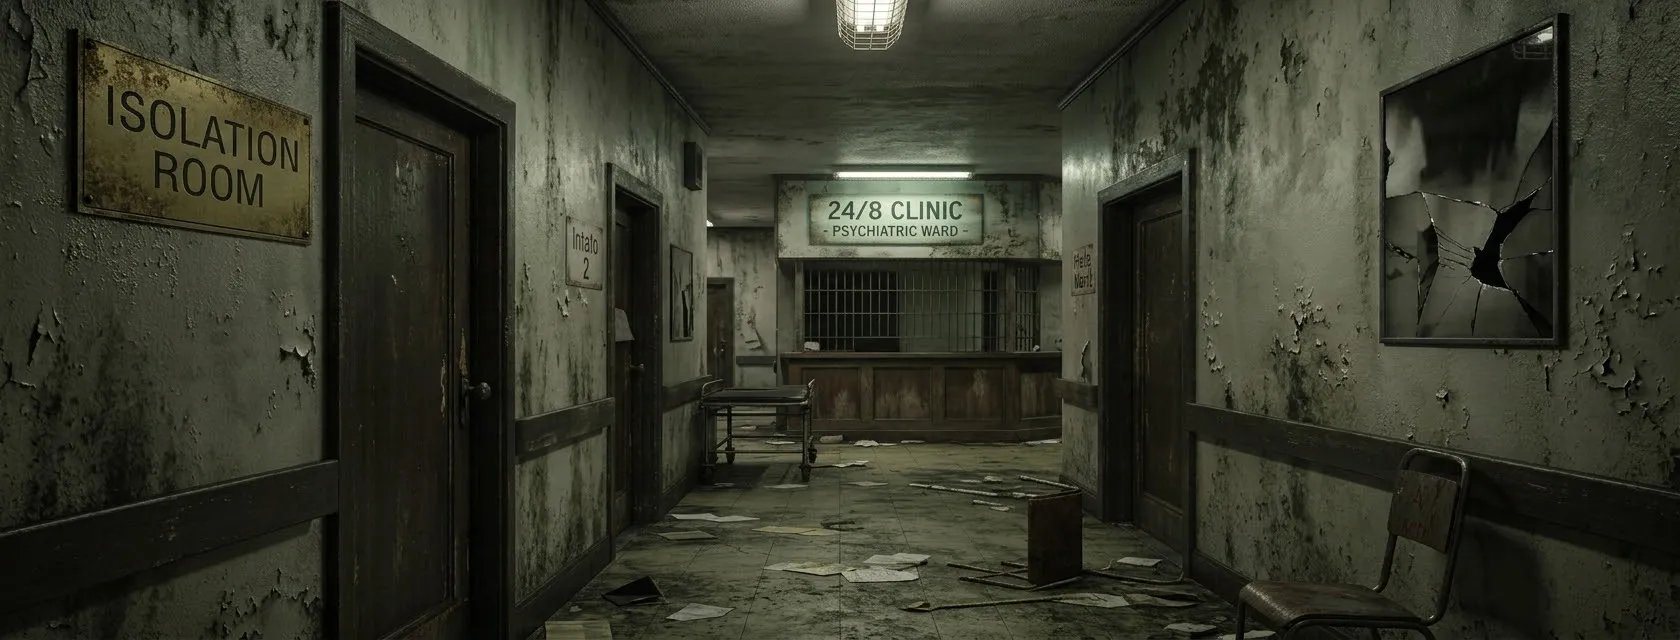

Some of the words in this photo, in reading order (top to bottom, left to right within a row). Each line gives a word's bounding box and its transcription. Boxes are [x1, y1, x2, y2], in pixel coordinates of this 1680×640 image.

[107, 84, 299, 173] ISOLATION
[154, 150, 264, 208] ROOM
[828, 200, 883, 221] 24/8
[891, 200, 964, 221] CLINIC
[832, 225, 918, 238] PSYCHIATRIC
[921, 225, 959, 238] WARD
[583, 256, 590, 280] 2
